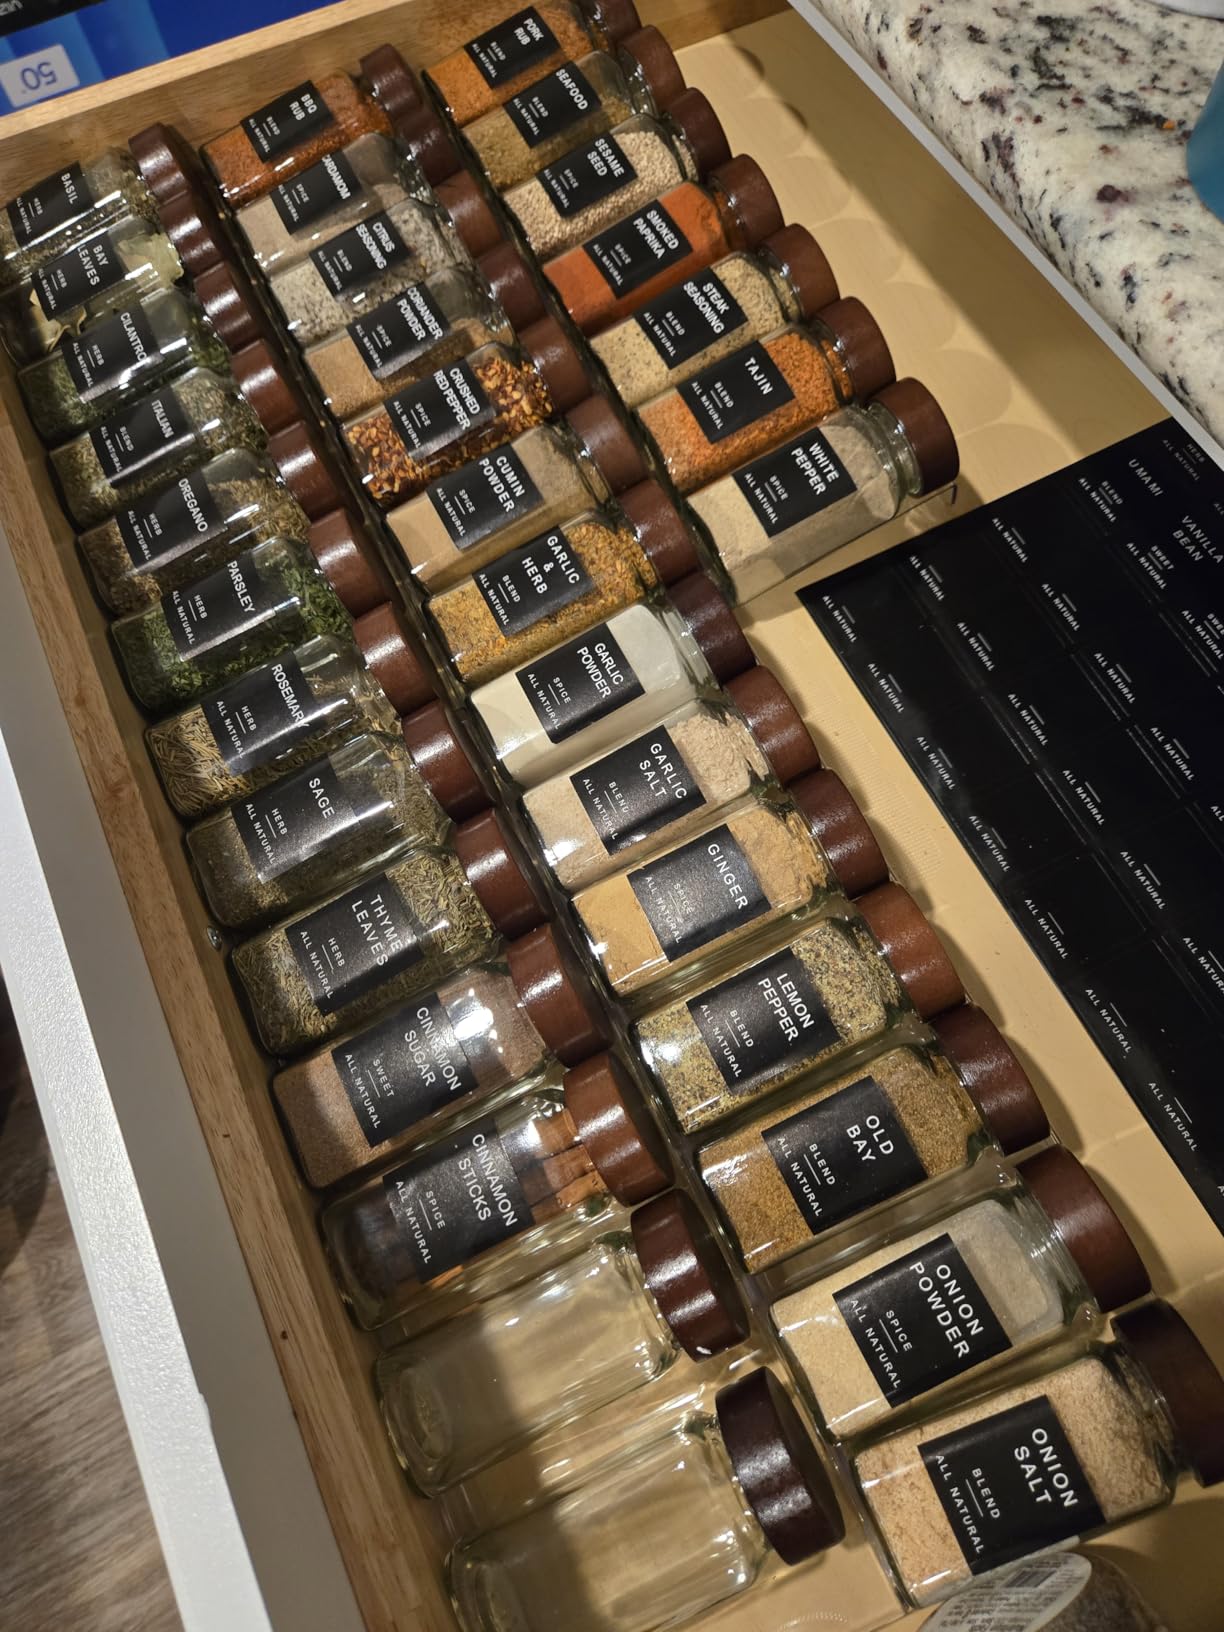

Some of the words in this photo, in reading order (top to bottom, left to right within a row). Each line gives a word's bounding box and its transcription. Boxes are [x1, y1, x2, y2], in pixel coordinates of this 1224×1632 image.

[514, 27, 530, 45] RUB
[524, 18, 544, 41] PORK
[290, 101, 305, 120] RUB
[301, 94, 317, 114] BBQ
[556, 69, 588, 110] SEAFOOD
[587, 151, 607, 176] SEED
[595, 138, 625, 177] SESAME
[61, 173, 78, 204] BASIL
[356, 224, 386, 269] SEASONING
[373, 222, 394, 252] CITRUS
[633, 218, 665, 259] PAPRIKA
[646, 210, 679, 249] SMOKED
[78, 244, 100, 286] LEAVES
[93, 245, 109, 266] BAY
[397, 299, 426, 340] POWDER
[407, 287, 442, 340] CORIANDER
[684, 282, 724, 333] SEASONING
[703, 283, 729, 314] STEAK
[120, 312, 147, 361] CILANTRO
[653, 325, 676, 356] NATURAL
[666, 311, 685, 335] BLEND
[450, 368, 480, 414] CRUSHED
[714, 382, 734, 408] BLEND
[745, 357, 773, 395] TAJIN
[151, 400, 174, 438] ITALIAN
[415, 403, 431, 426] SPICE
[433, 370, 449, 390] RED
[446, 390, 470, 430] PEPPER
[692, 382, 702, 395] ALL
[701, 395, 723, 430] NATURAL
[393, 401, 403, 414] ALL
[401, 414, 421, 448] NATURAL
[479, 458, 514, 512] POWDER
[496, 456, 525, 497] CUMIN
[792, 448, 826, 495] PEPPER
[809, 442, 839, 482] WHITE
[1128, 458, 1163, 496] UMAMI
[178, 478, 208, 532] OREGANO
[459, 489, 475, 513] SPICE
[744, 473, 755, 488] ALL
[754, 488, 778, 524] NATURAL
[770, 475, 788, 500] SPICE
[1090, 491, 1116, 522] NATURAL
[1102, 480, 1123, 505] BLEND
[149, 513, 162, 536] HERB
[437, 488, 446, 501] ALL
[444, 502, 466, 536] NATURAL
[133, 525, 152, 560] NATURAL
[547, 536, 580, 584] GARLIC
[1151, 545, 1174, 570] SWEET
[1172, 530, 1204, 561] BEAN
[1182, 515, 1224, 564] VANILLA
[227, 561, 255, 612] PARSLEY
[502, 575, 520, 602] BLEND
[522, 557, 547, 594] HERB
[543, 562, 554, 572] &
[1126, 542, 1139, 556] ALL
[1138, 556, 1167, 589] NATURAL
[194, 594, 208, 619] HERB
[479, 574, 488, 588] ALL
[488, 589, 509, 625] NATURAL
[177, 606, 195, 644] NATURAL
[577, 647, 611, 698] POWDER
[595, 642, 623, 685] GARLIC
[1094, 653, 1108, 668] ALL
[1106, 668, 1136, 704] NATURAL
[217, 701, 225, 716] ALL
[272, 664, 309, 727] ROSEMARY
[528, 673, 538, 688] ALL
[537, 690, 560, 729] NATURAL
[553, 677, 570, 704] SPICE
[241, 705, 256, 731] HERB
[1008, 694, 1021, 708] ALL
[1020, 709, 1048, 746] NATURAL
[651, 743, 687, 799] GARLIC
[916, 736, 930, 752] ALL
[928, 752, 956, 790] NATURAL
[1150, 727, 1164, 742] ALL
[1163, 743, 1194, 780] NATURAL
[309, 778, 335, 818] SAGE
[609, 782, 628, 813] BLEND
[640, 760, 666, 797] SALT
[1062, 770, 1076, 785] ALL
[1075, 786, 1104, 825] NATURAL
[272, 808, 287, 835] HERB
[583, 778, 594, 795] ALL
[593, 797, 619, 839] NATURAL
[246, 803, 256, 821] ALL
[254, 822, 275, 865] NATURAL
[969, 816, 982, 831] ALL
[981, 832, 1010, 872] NATURAL
[708, 844, 748, 909] GINGER
[1120, 851, 1135, 868] ALL
[1134, 869, 1165, 909] NATURAL
[370, 894, 402, 952] THYME
[644, 876, 657, 894] ALL
[656, 898, 682, 943] NATURAL
[1024, 899, 1039, 916] ALL
[1038, 918, 1068, 959] NATURAL
[329, 937, 345, 966] HERB
[352, 900, 388, 966] LEAVES
[300, 932, 311, 949] ALL
[310, 952, 334, 998] NATURAL
[758, 978, 799, 1041] PEPPER
[777, 973, 814, 1028] LEMON
[1085, 988, 1100, 1006] ALL
[1099, 1009, 1132, 1053] NATURAL
[417, 1007, 461, 1090] CINNAMON
[701, 1004, 715, 1023] ALL
[712, 1027, 742, 1077] NATURAL
[730, 1009, 754, 1047] BLEND
[373, 1059, 394, 1097] SWEET
[405, 1030, 436, 1086] SUGAR
[345, 1054, 356, 1074] ALL
[355, 1077, 380, 1128] NATURAL
[866, 1115, 894, 1154] OLD
[1148, 1082, 1163, 1100] ALL
[1164, 1104, 1198, 1151] NATURAL
[809, 1143, 836, 1185] BLEND
[846, 1124, 876, 1161] BAY
[459, 1158, 491, 1220] STICKS
[472, 1134, 517, 1226] CINNAMON
[778, 1137, 792, 1158] ALL
[791, 1162, 823, 1217] NATURAL
[395, 1181, 408, 1203] ALL
[405, 1207, 432, 1263] NATURAL
[426, 1190, 446, 1228] SPICE
[910, 1261, 970, 1358] POWDER
[936, 1264, 984, 1336] ONION
[850, 1300, 866, 1323] ALL
[865, 1327, 901, 1388] NATURAL
[886, 1309, 913, 1352] SPICE
[1014, 1446, 1052, 1502] SALT
[1032, 1428, 1078, 1507] ONION
[936, 1454, 952, 1480] ALL
[950, 1487, 984, 1553] NATURAL
[972, 1468, 1000, 1518] BLEND
